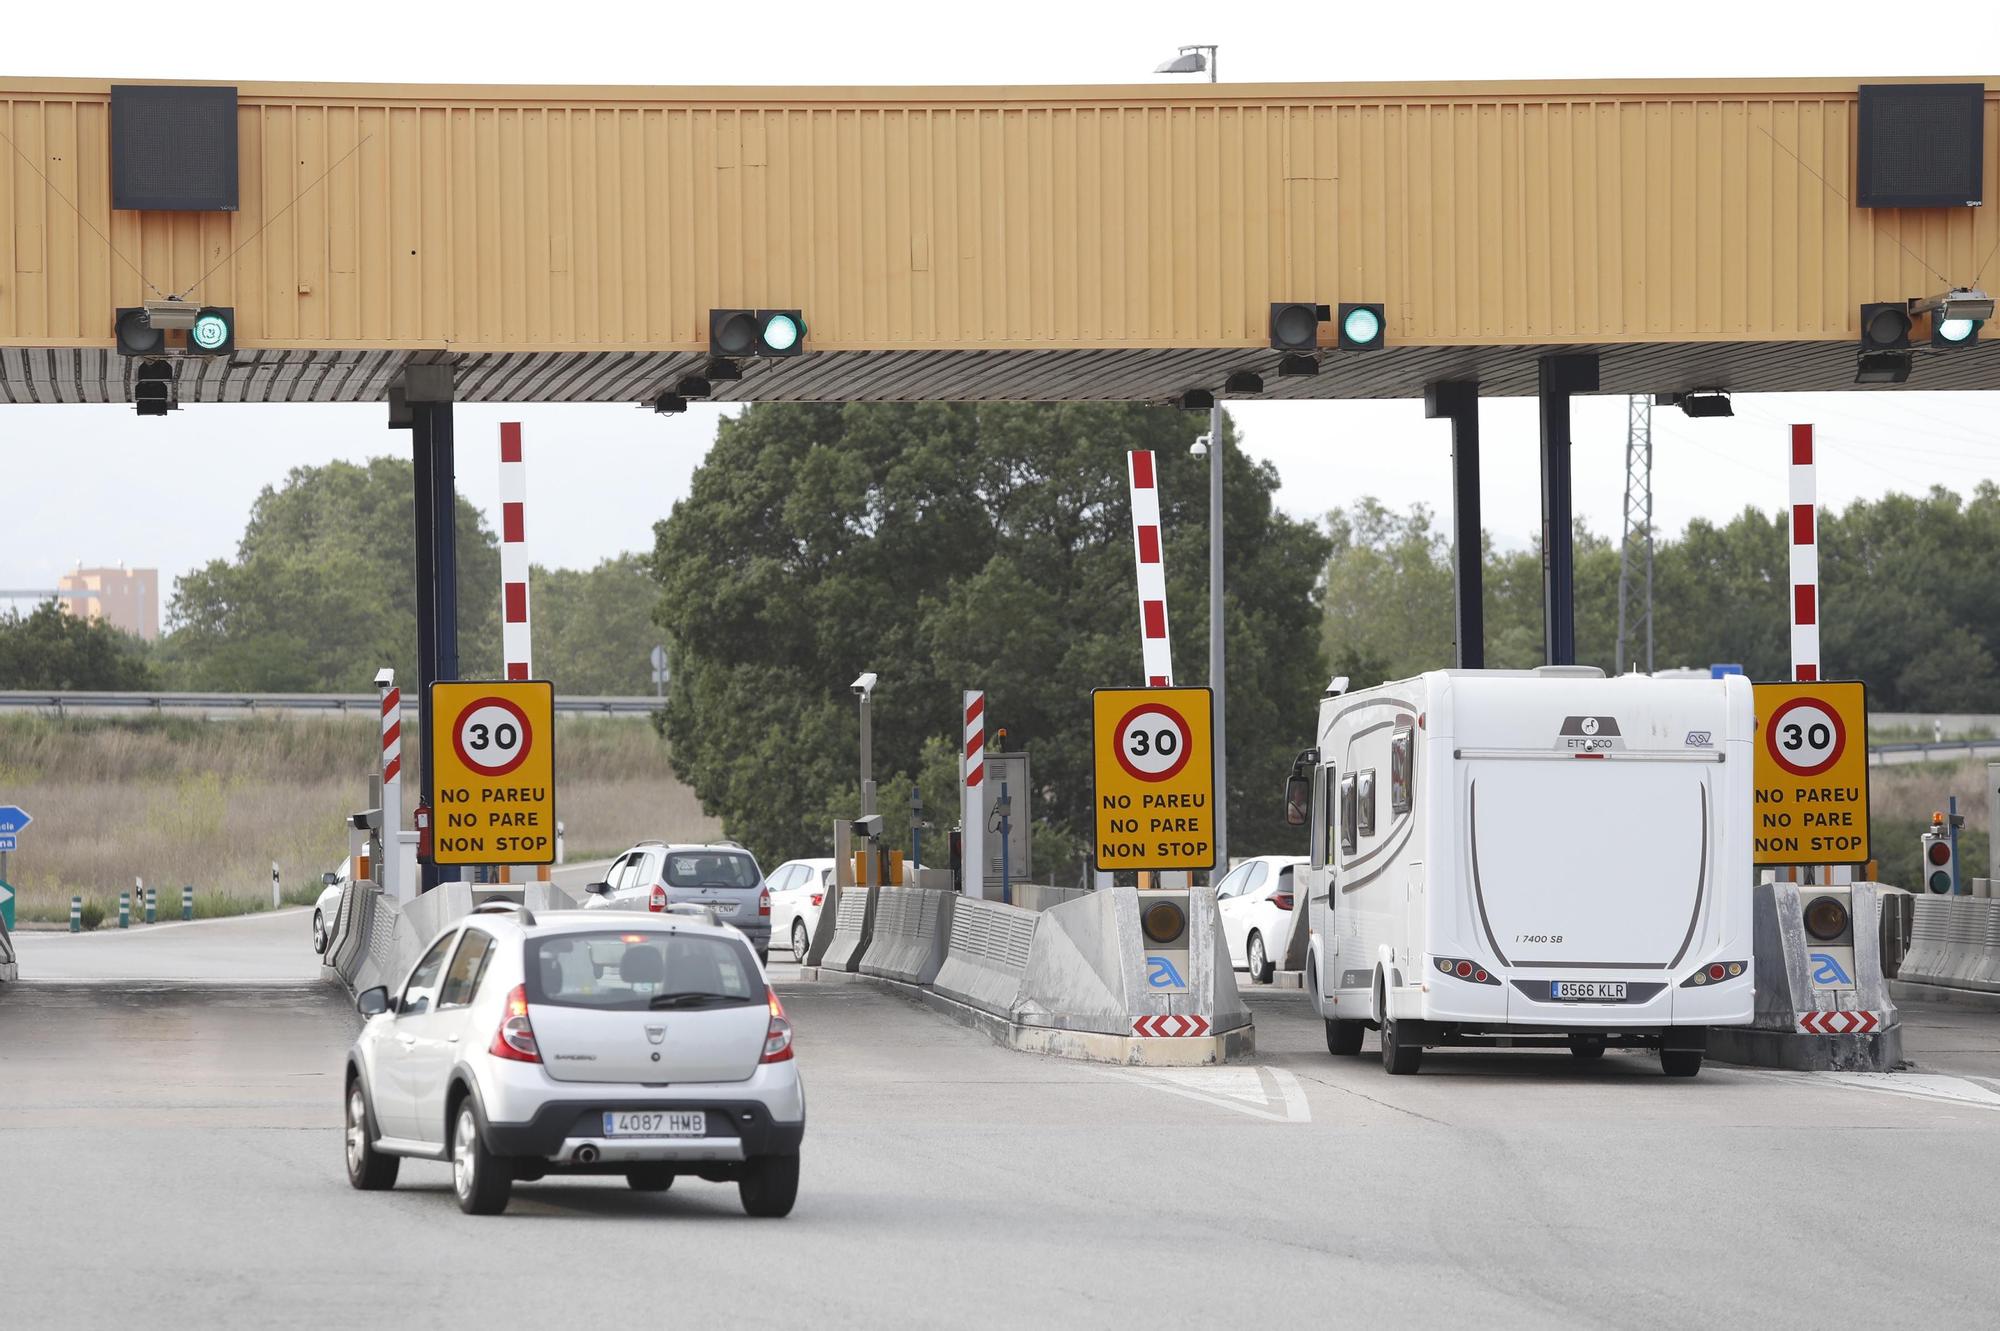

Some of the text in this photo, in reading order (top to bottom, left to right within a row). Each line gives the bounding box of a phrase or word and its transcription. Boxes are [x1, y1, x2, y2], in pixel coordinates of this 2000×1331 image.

[469, 723, 517, 750] 30
[1130, 729, 1176, 756] 30
[1567, 739, 1612, 748] ETRSCO
[1783, 723, 1830, 750] 30
[441, 788, 545, 803] NO PAREU
[1103, 794, 1205, 809] NO PAREU
[1755, 788, 1858, 803] NO PAREU
[449, 812, 538, 827] NO PARE
[1111, 818, 1198, 833] NO PARE
[1763, 812, 1852, 827] NO PARE
[440, 836, 547, 852] NON STOP
[1102, 842, 1208, 858] NON STOP
[1755, 836, 1862, 852] NON STOP
[1523, 935, 1548, 943] 7400
[1550, 935, 1563, 943] SB
[1561, 983, 1624, 997] 8566 KLR
[619, 1114, 703, 1131] 4087 HMB
